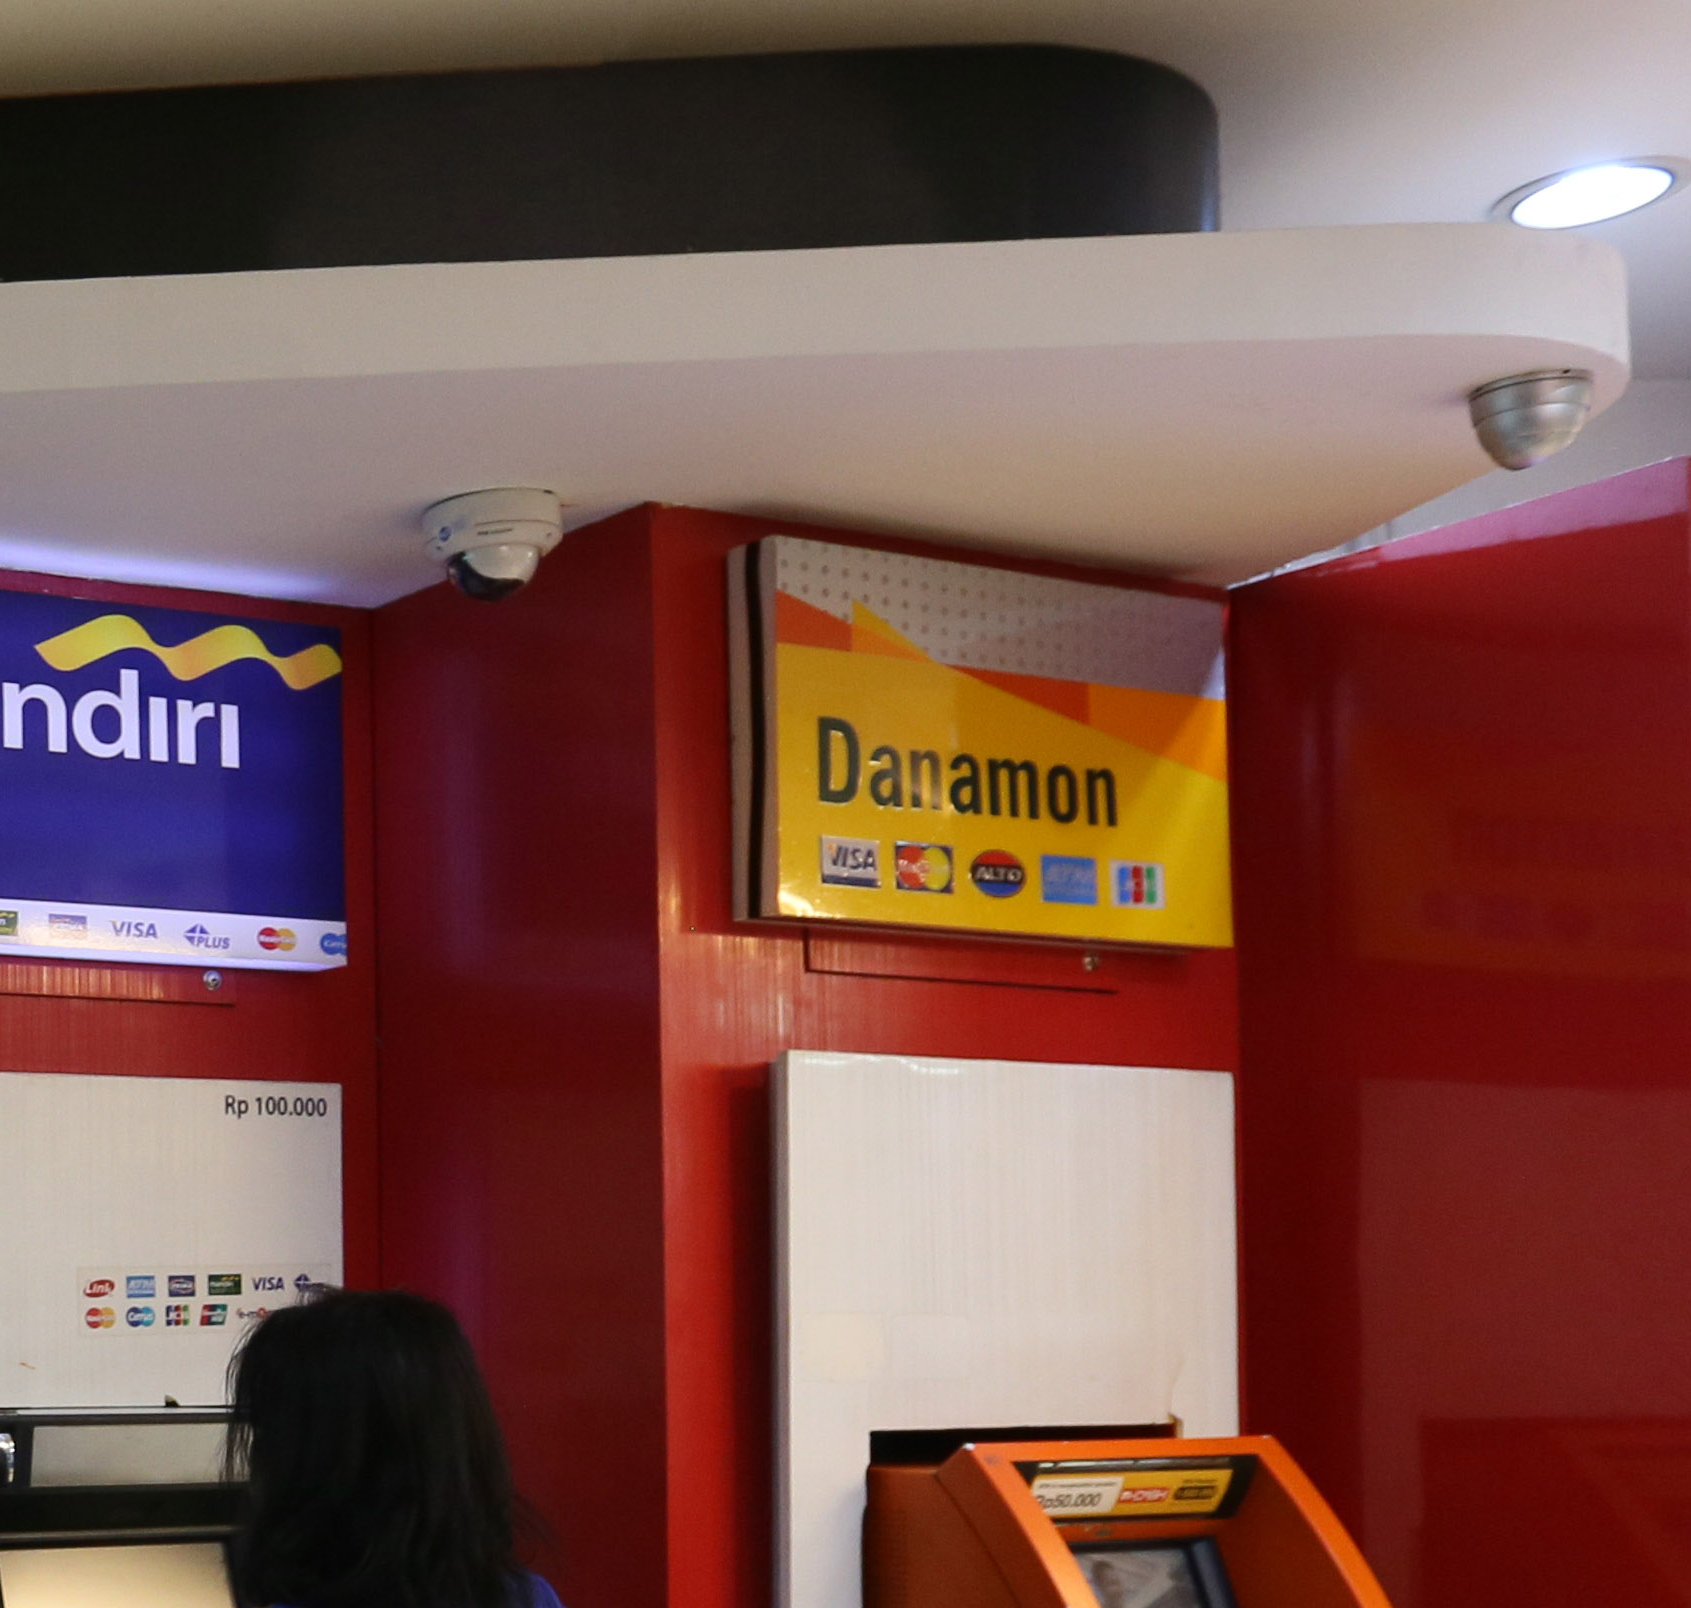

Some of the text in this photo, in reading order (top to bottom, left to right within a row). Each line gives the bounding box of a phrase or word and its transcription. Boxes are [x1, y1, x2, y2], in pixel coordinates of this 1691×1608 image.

[817, 716, 1117, 827] Danamon
[829, 843, 877, 871] VISA
[975, 867, 1022, 881] ALTO
[110, 920, 158, 940] VISA
[196, 937, 230, 949] PLUS
[224, 1095, 328, 1119] Rp 100.000
[86, 1281, 112, 1294] Link
[251, 1277, 284, 1291] VISA
